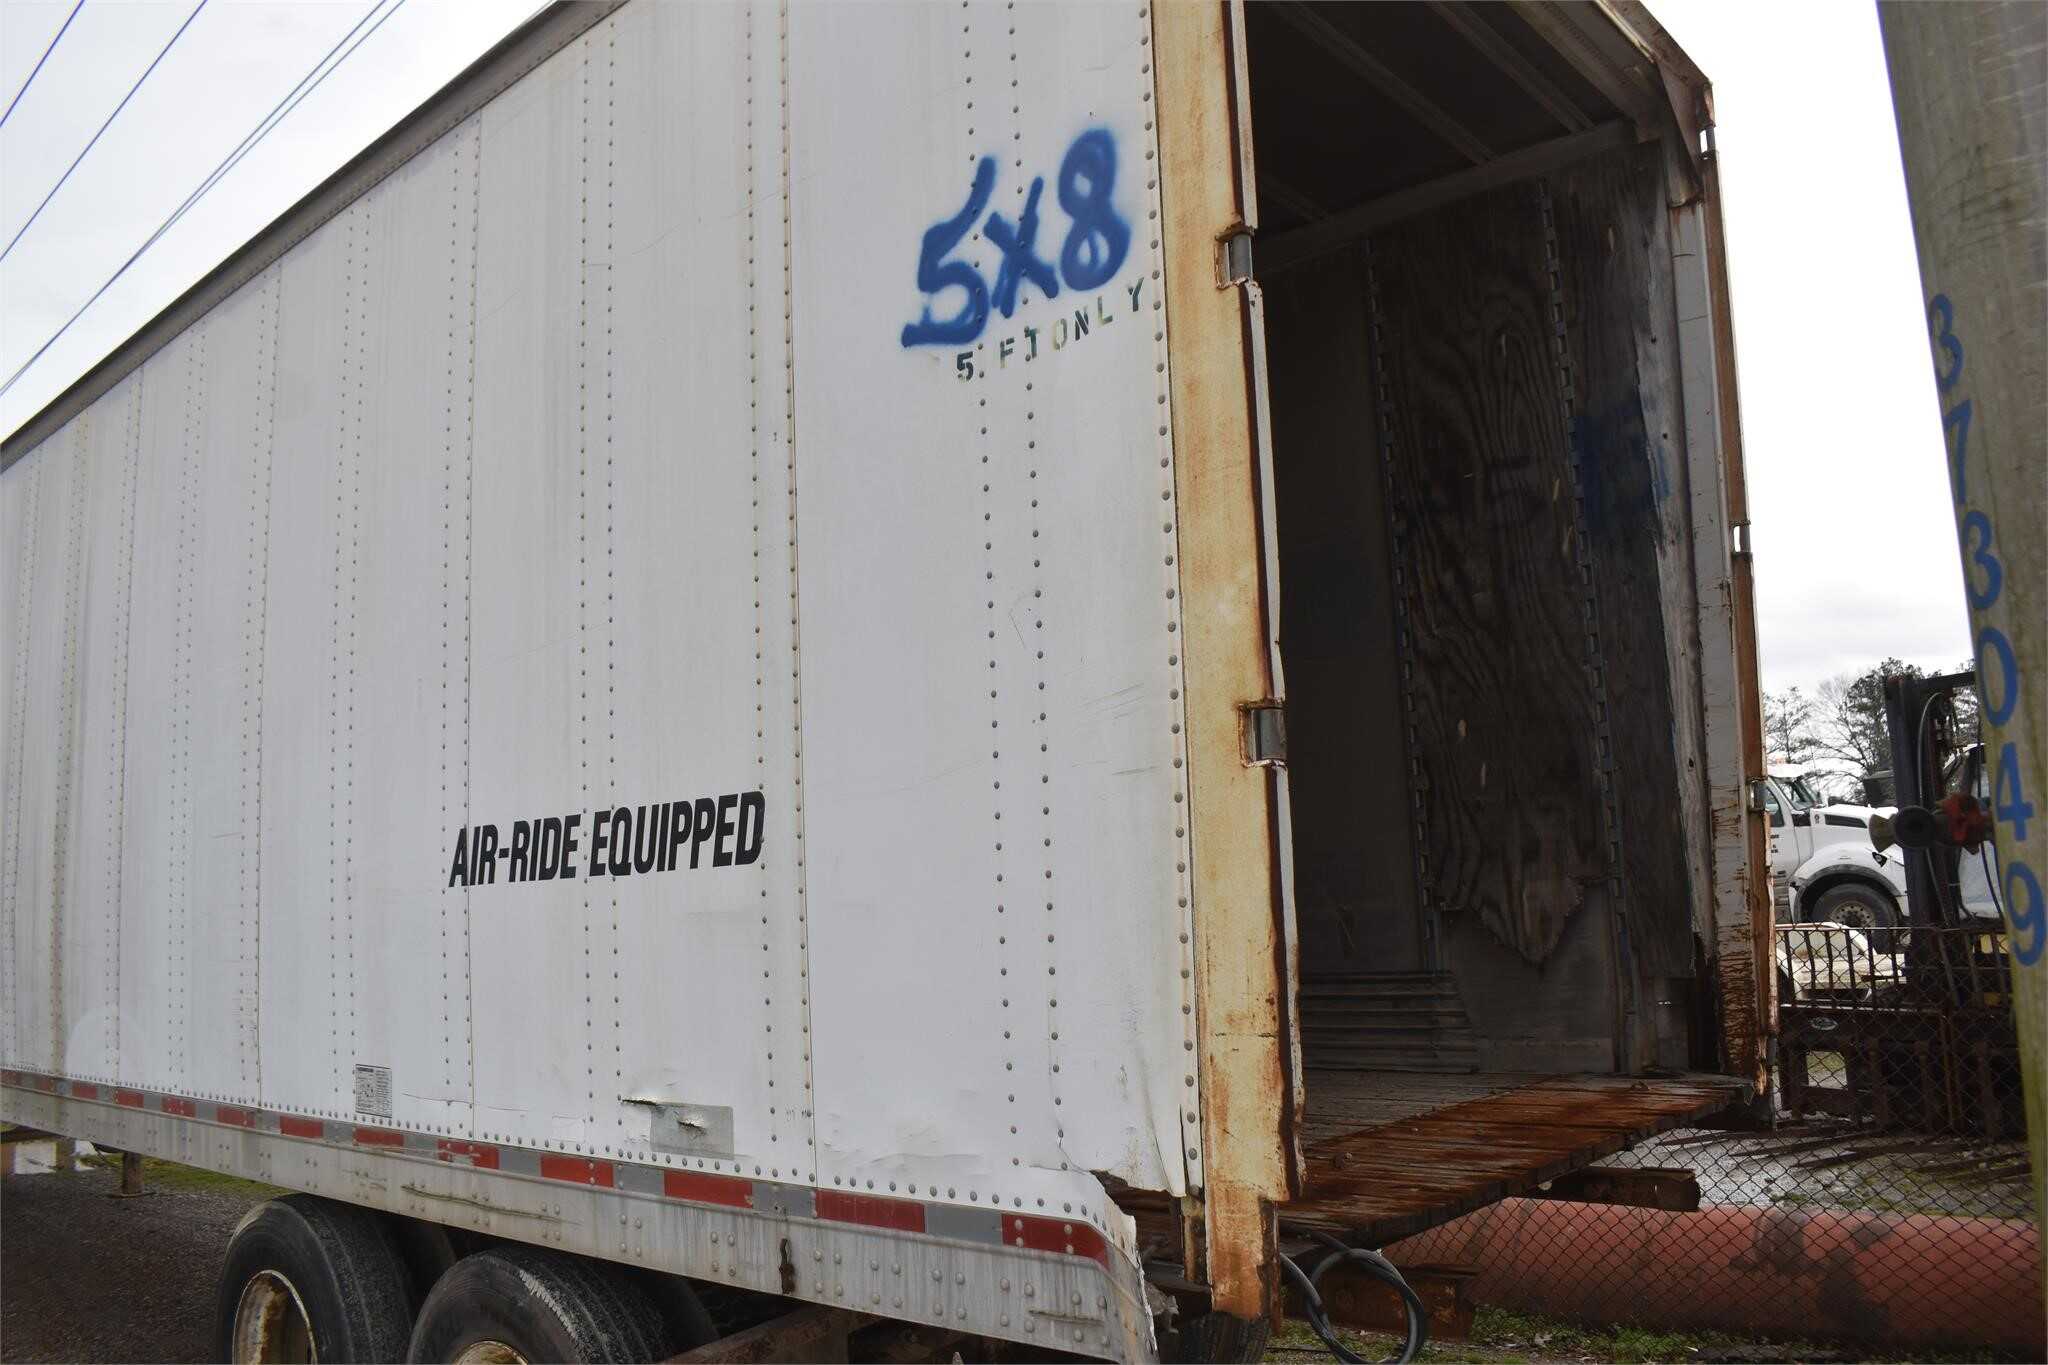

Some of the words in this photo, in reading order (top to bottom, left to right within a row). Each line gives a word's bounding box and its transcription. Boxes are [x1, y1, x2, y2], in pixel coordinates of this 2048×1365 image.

[956, 351, 974, 381] 5
[999, 327, 1040, 369] FT
[1054, 276, 1145, 351] ONLY
[448, 814, 581, 887] AIR-RIDE
[589, 791, 766, 877] EQUIPPED
